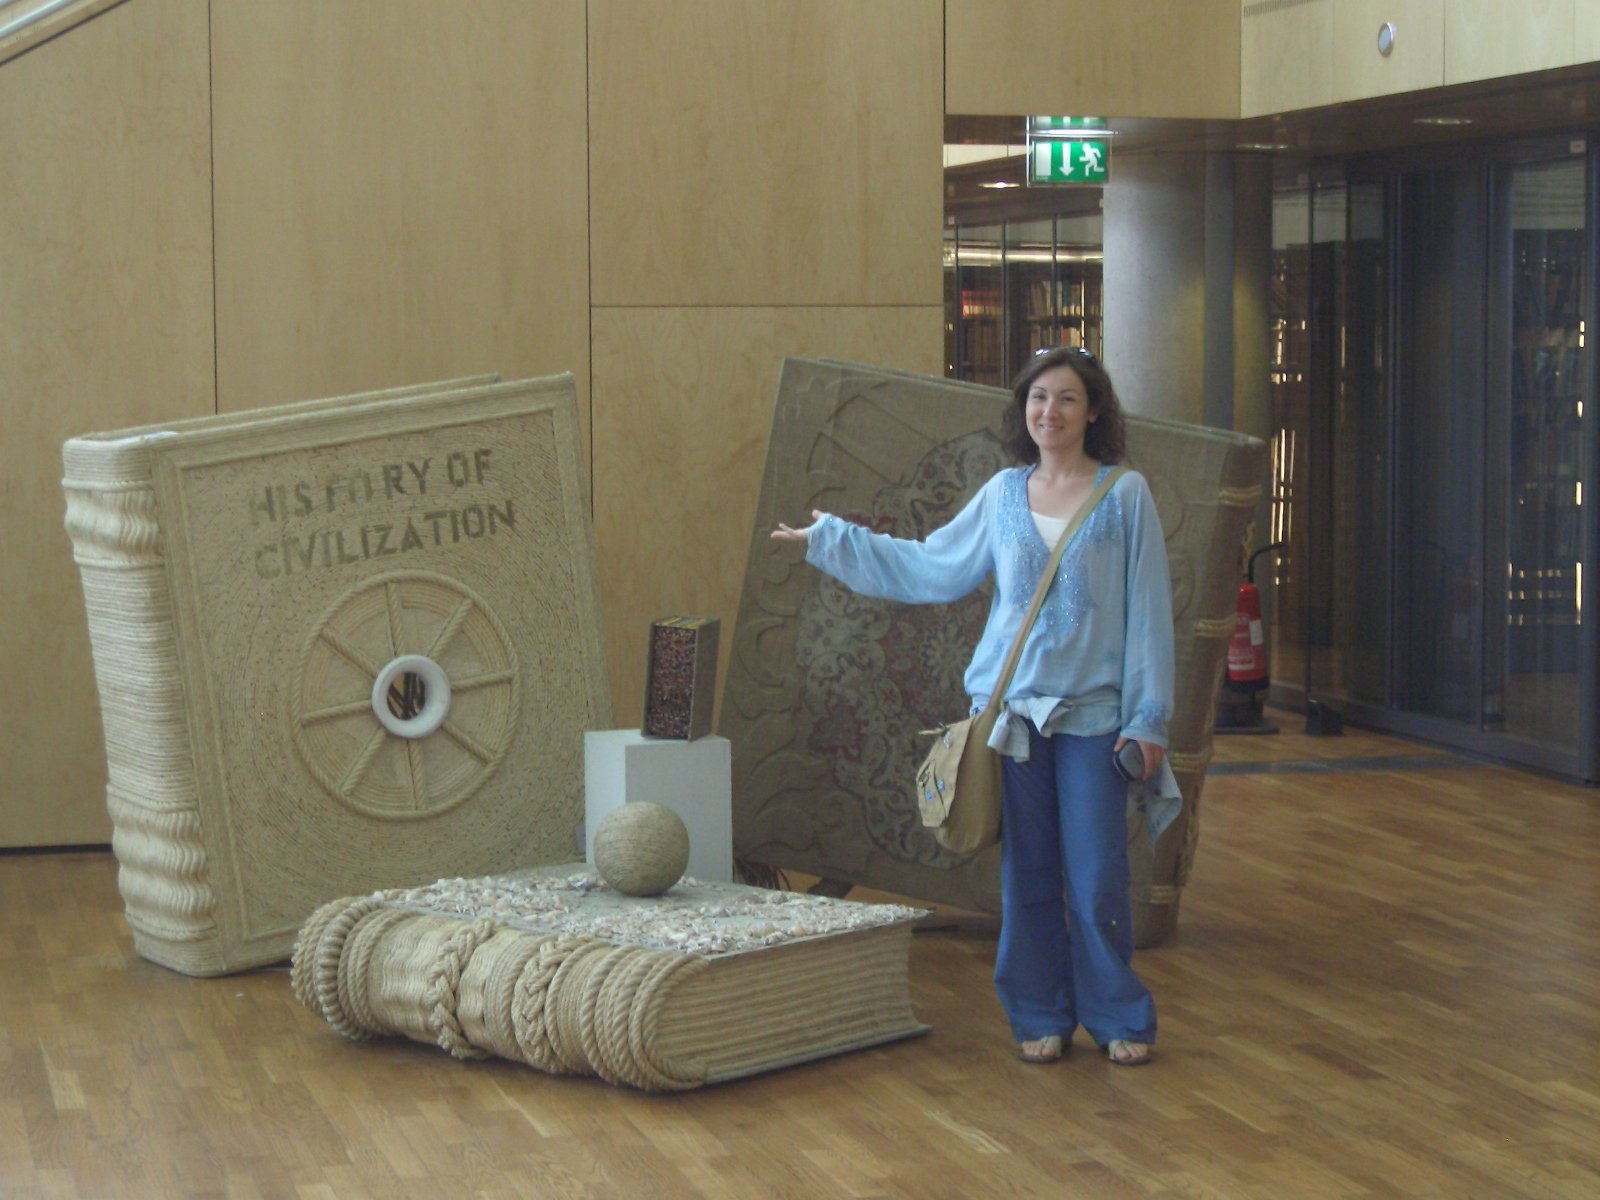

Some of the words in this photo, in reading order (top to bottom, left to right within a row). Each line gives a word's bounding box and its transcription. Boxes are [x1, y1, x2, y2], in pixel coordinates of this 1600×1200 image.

[250, 458, 431, 522] HISTORY
[447, 449, 493, 488] OF
[255, 499, 516, 579] CIVILIZATION
